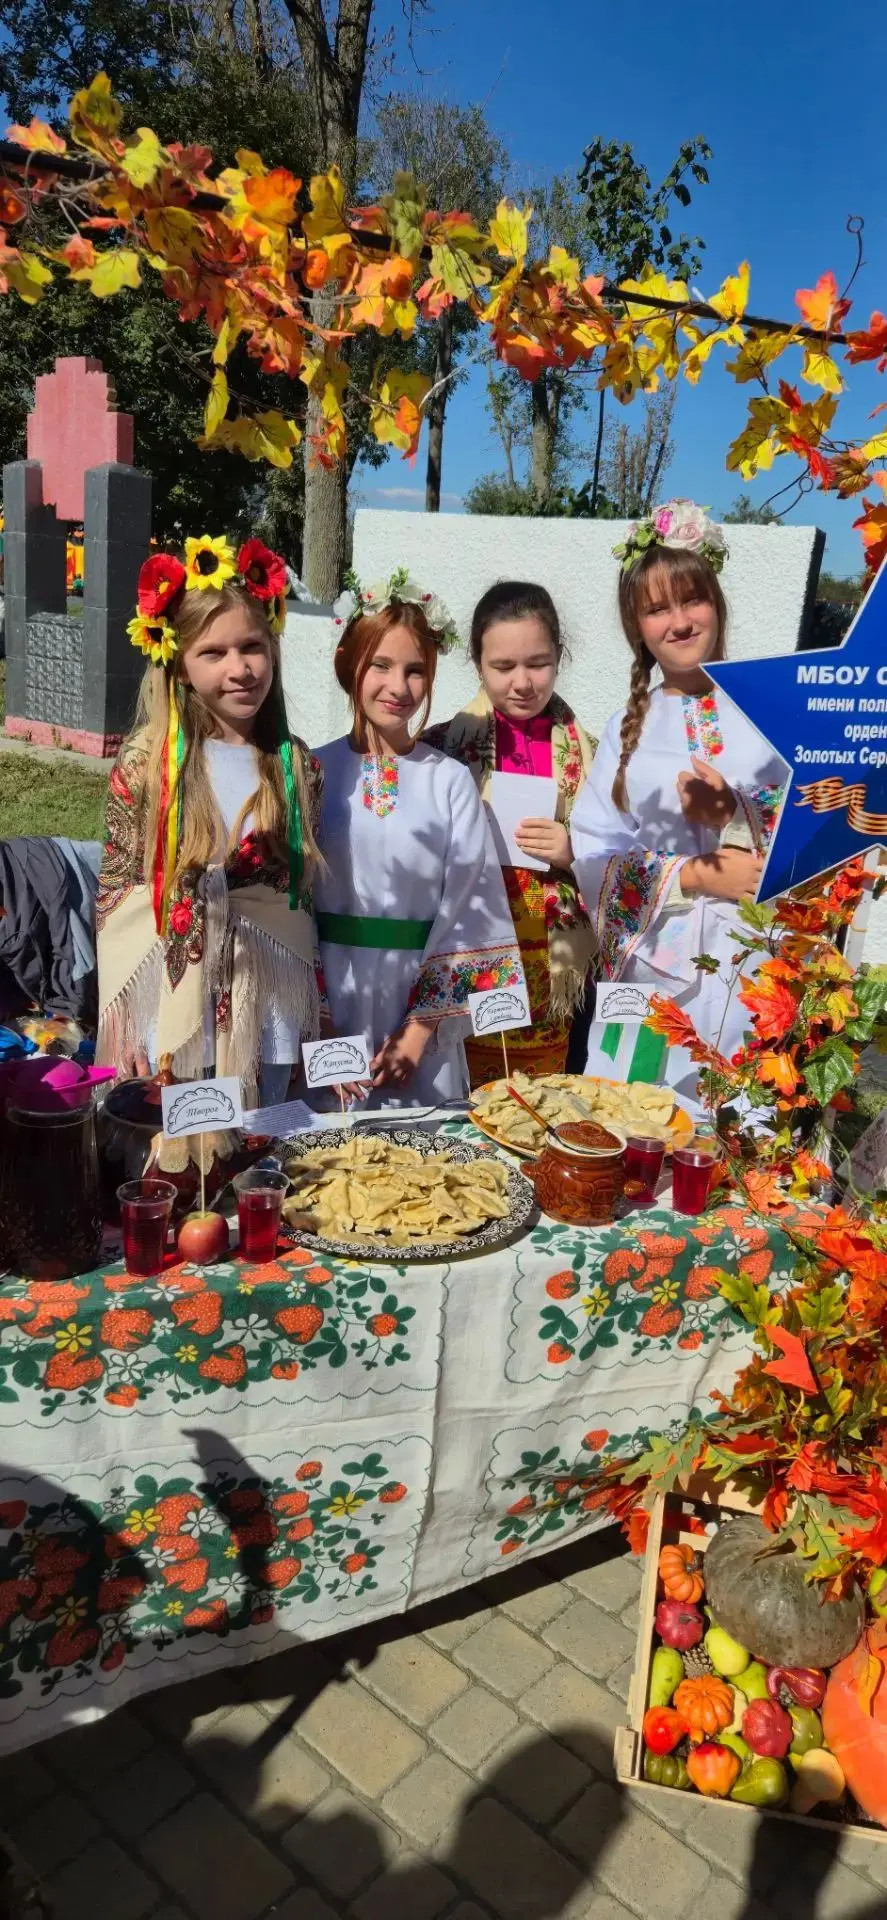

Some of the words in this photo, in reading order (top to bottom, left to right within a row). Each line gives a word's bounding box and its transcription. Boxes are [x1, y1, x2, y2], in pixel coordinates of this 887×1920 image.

[796, 665, 870, 685] МБОУ
[807, 697, 855, 712] имени
[858, 698, 887, 713] пол
[794, 744, 856, 764] Золотых
[859, 746, 887, 769] Сер
